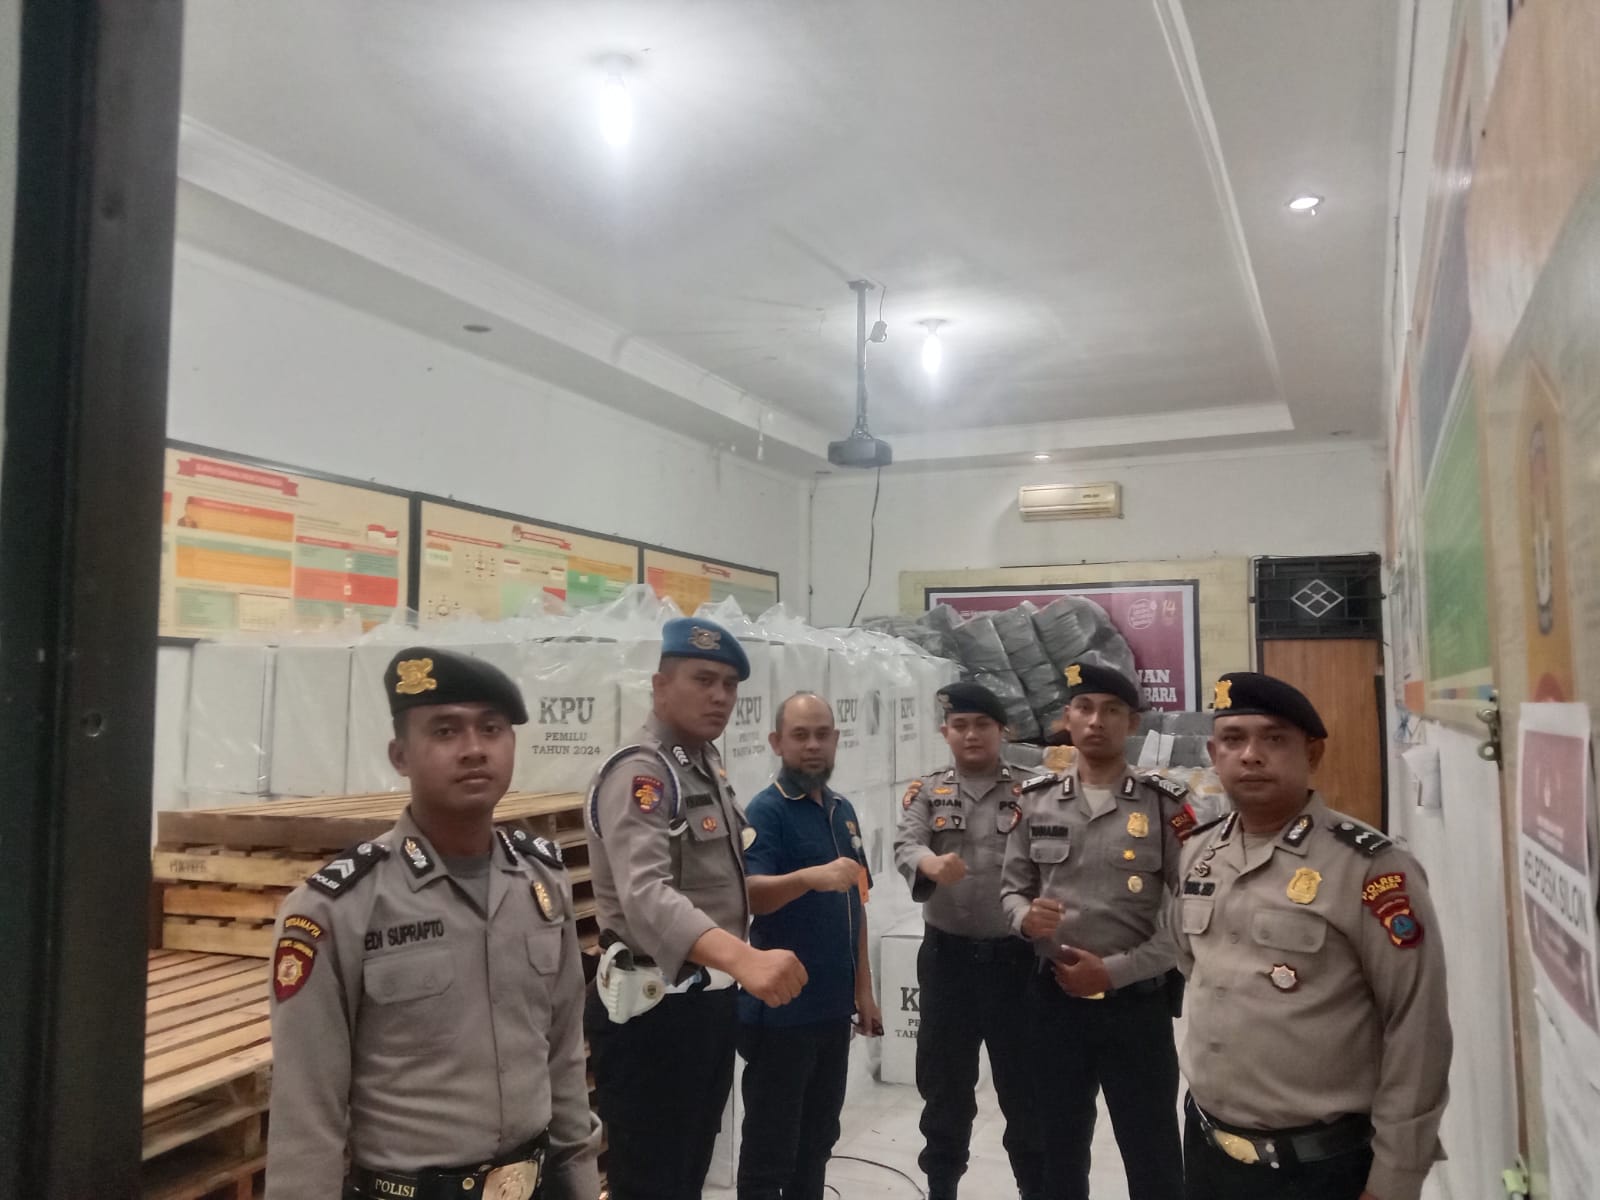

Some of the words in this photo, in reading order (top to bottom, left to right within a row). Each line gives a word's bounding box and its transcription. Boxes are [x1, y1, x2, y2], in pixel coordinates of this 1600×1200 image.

[538, 696, 595, 725] KPU
[735, 696, 762, 726] KPU
[836, 698, 858, 723] KPU
[545, 732, 587, 741] PEMILU
[531, 745, 570, 755] TAHUN
[573, 745, 601, 755] 2024
[1362, 875, 1403, 901] POLRES
[364, 929, 383, 950] EDI
[387, 919, 445, 946] SUPRAPTO
[895, 1029, 918, 1038] TAH
[375, 1178, 416, 1197] POLISI
